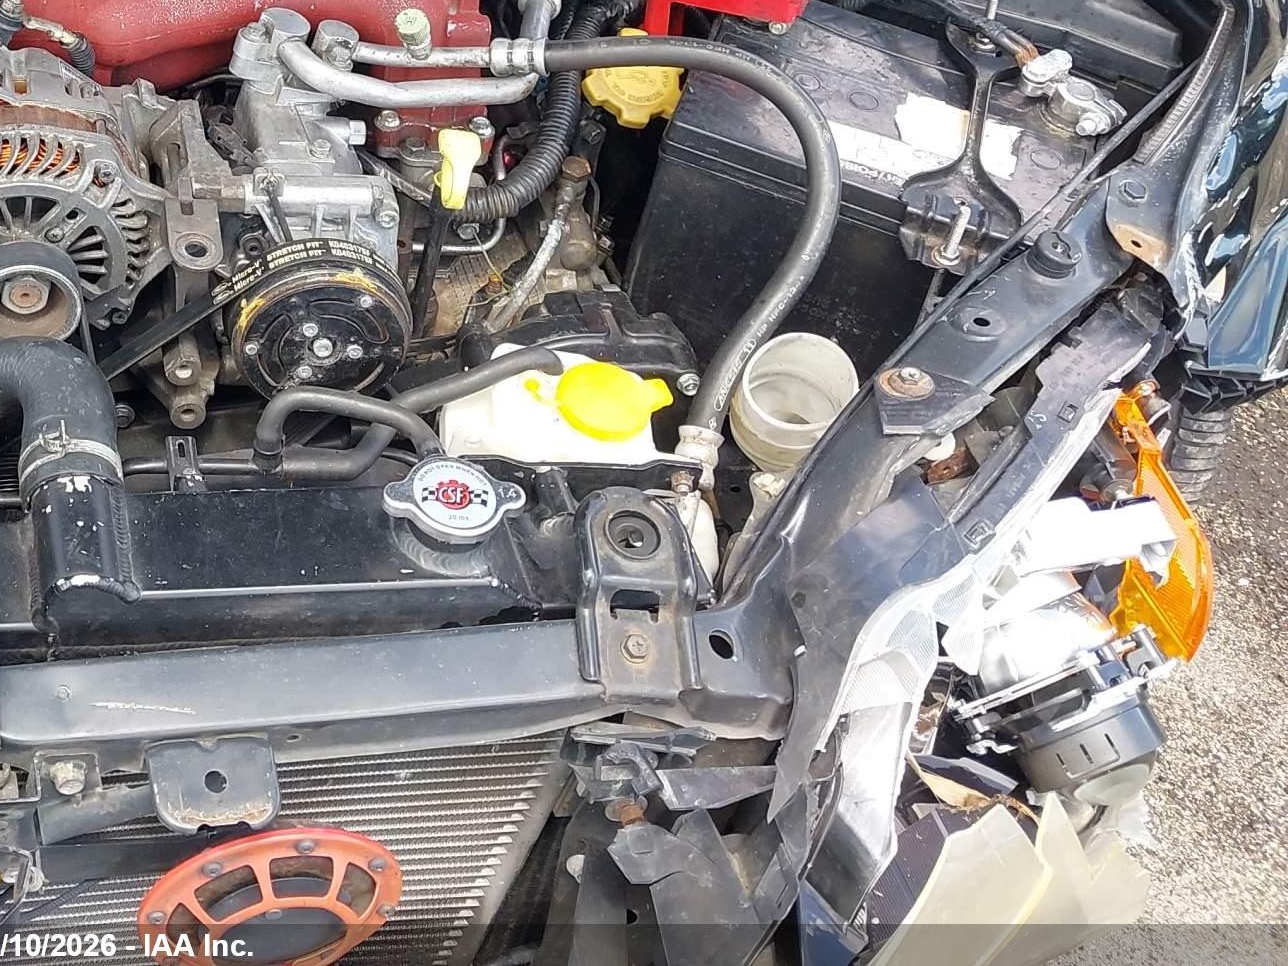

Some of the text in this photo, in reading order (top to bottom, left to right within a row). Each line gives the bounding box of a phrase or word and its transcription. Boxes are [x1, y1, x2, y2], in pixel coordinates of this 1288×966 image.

[267, 242, 305, 262] STRETCH
[269, 250, 307, 269] STRETCH
[438, 486, 465, 505] CSF
